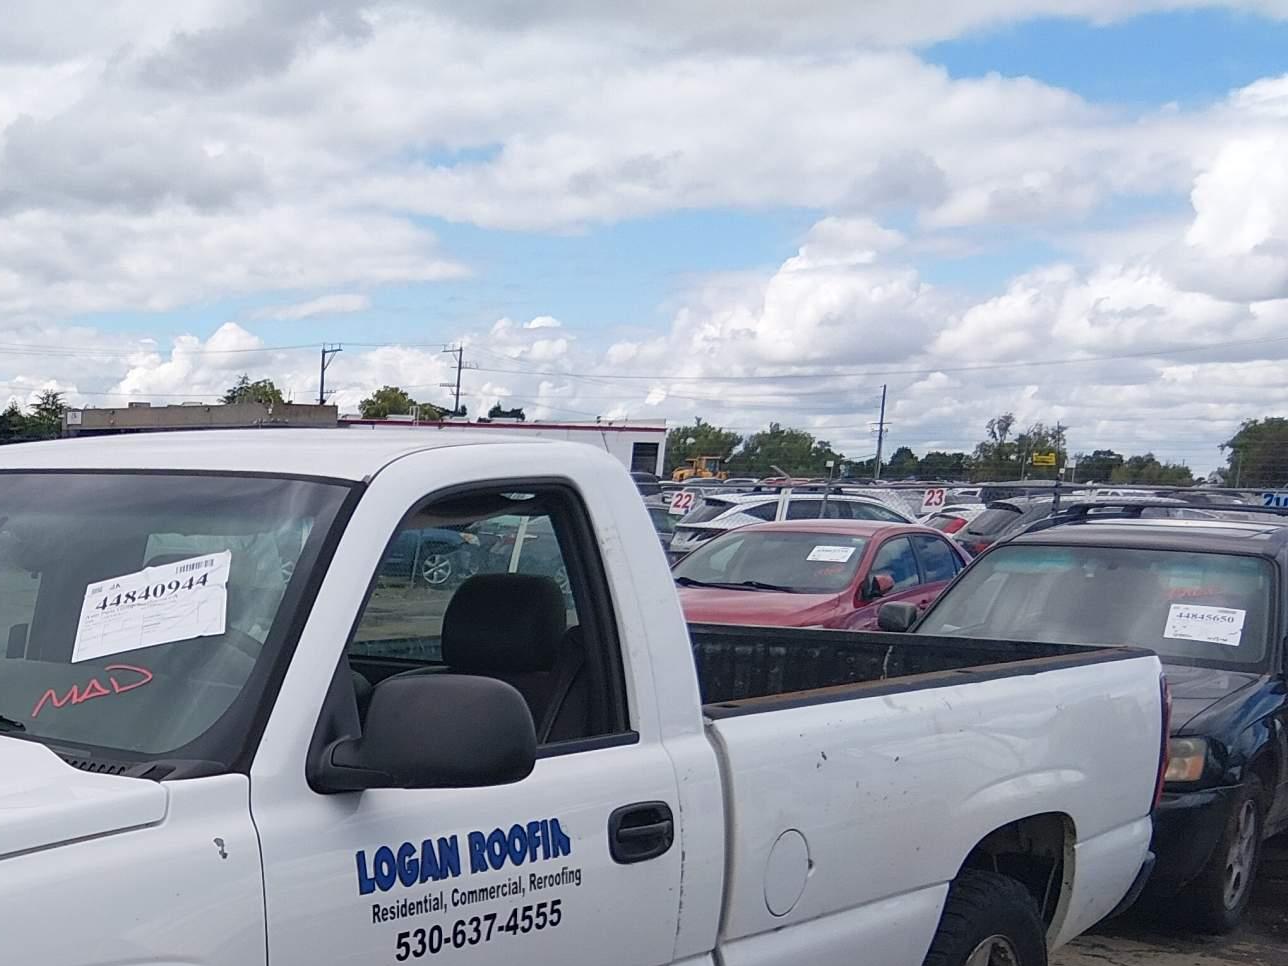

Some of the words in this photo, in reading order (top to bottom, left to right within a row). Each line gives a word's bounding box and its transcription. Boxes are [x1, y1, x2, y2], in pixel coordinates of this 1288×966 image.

[673, 493, 692, 508] 22
[924, 489, 944, 506] 23
[95, 572, 209, 611] 44840944
[1176, 612, 1234, 623] 44845650
[31, 664, 153, 719] MAD
[355, 834, 461, 896] LOGAN
[372, 891, 447, 924] Residential,
[451, 875, 525, 908] Commercial,
[529, 866, 582, 892] Reroofing
[395, 899, 562, 962] 530-637-4555
